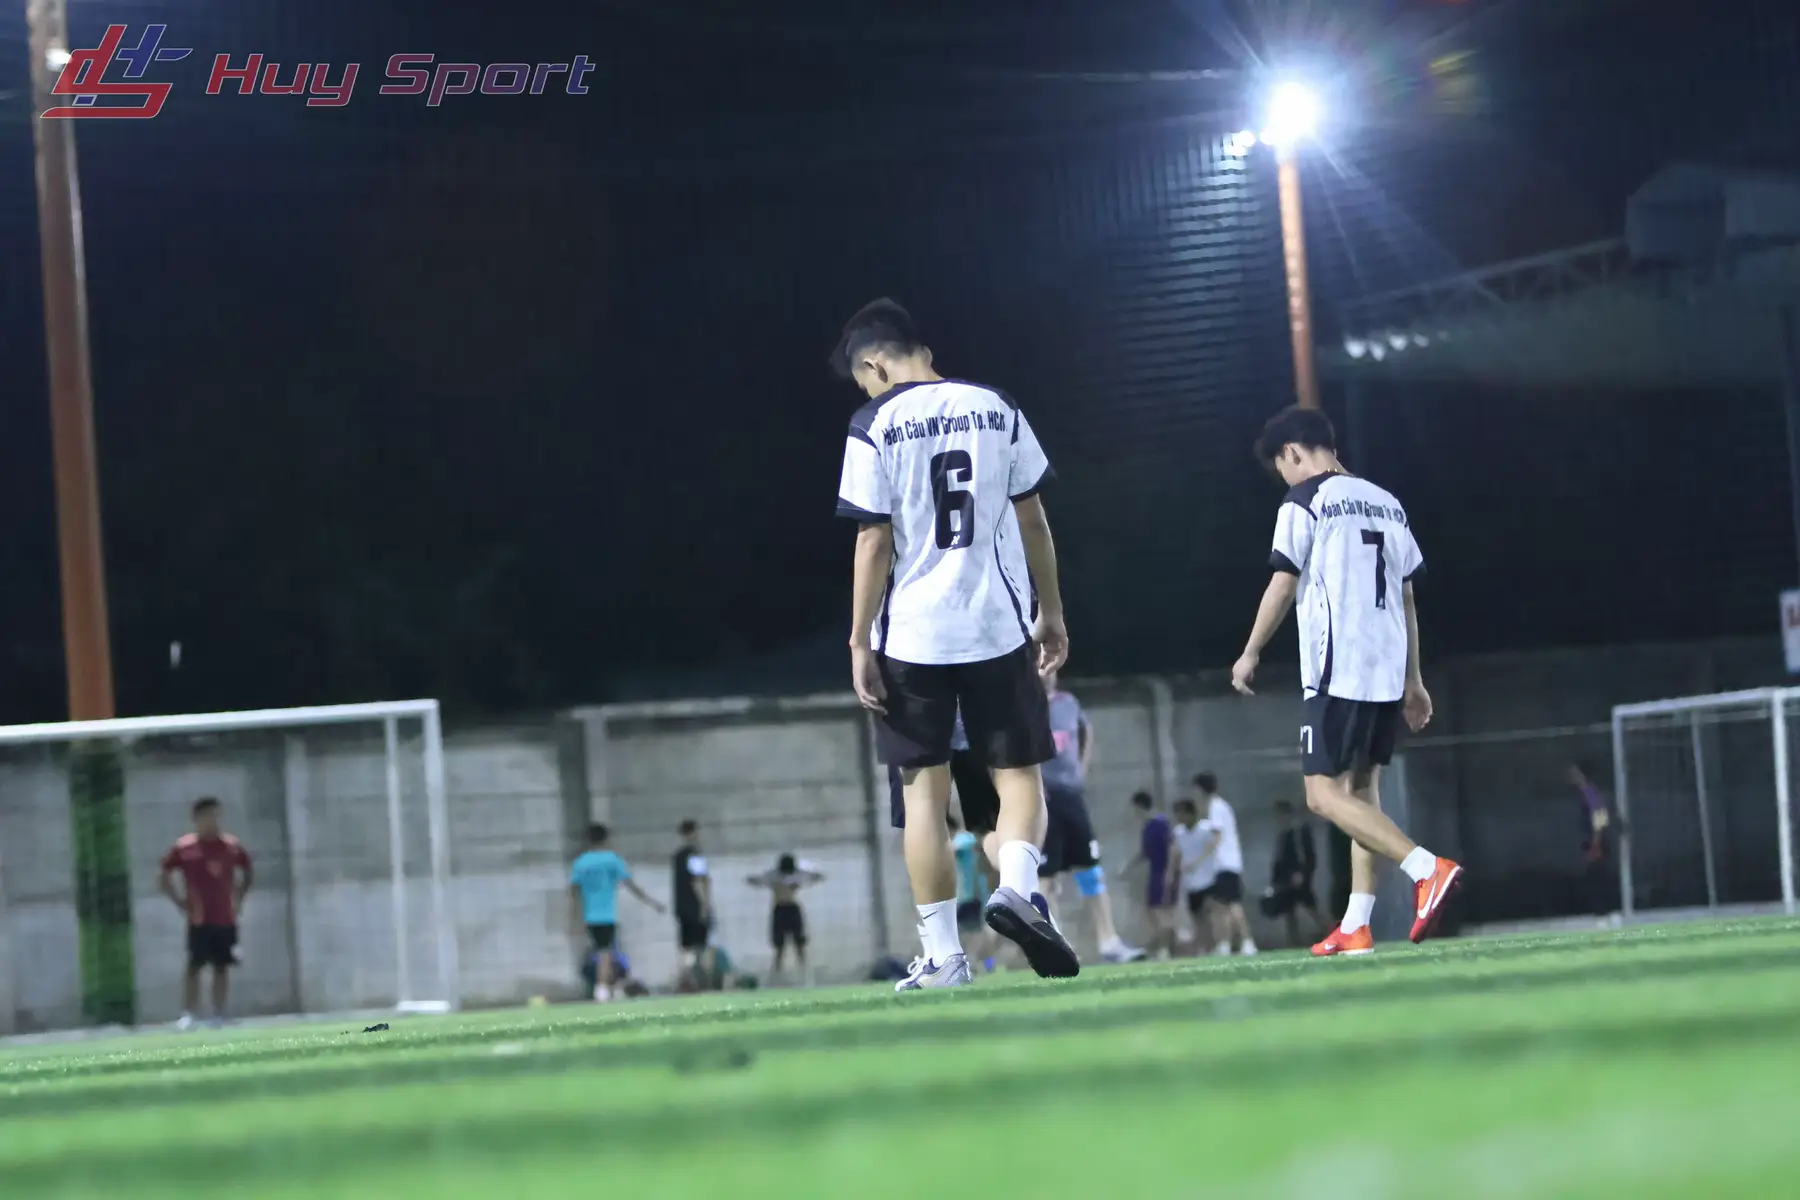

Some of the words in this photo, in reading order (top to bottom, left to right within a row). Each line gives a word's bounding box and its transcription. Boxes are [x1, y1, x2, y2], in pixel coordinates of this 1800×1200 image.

[940, 414, 970, 434] Group
[930, 449, 975, 550] 6
[1360, 529, 1386, 610] 7
